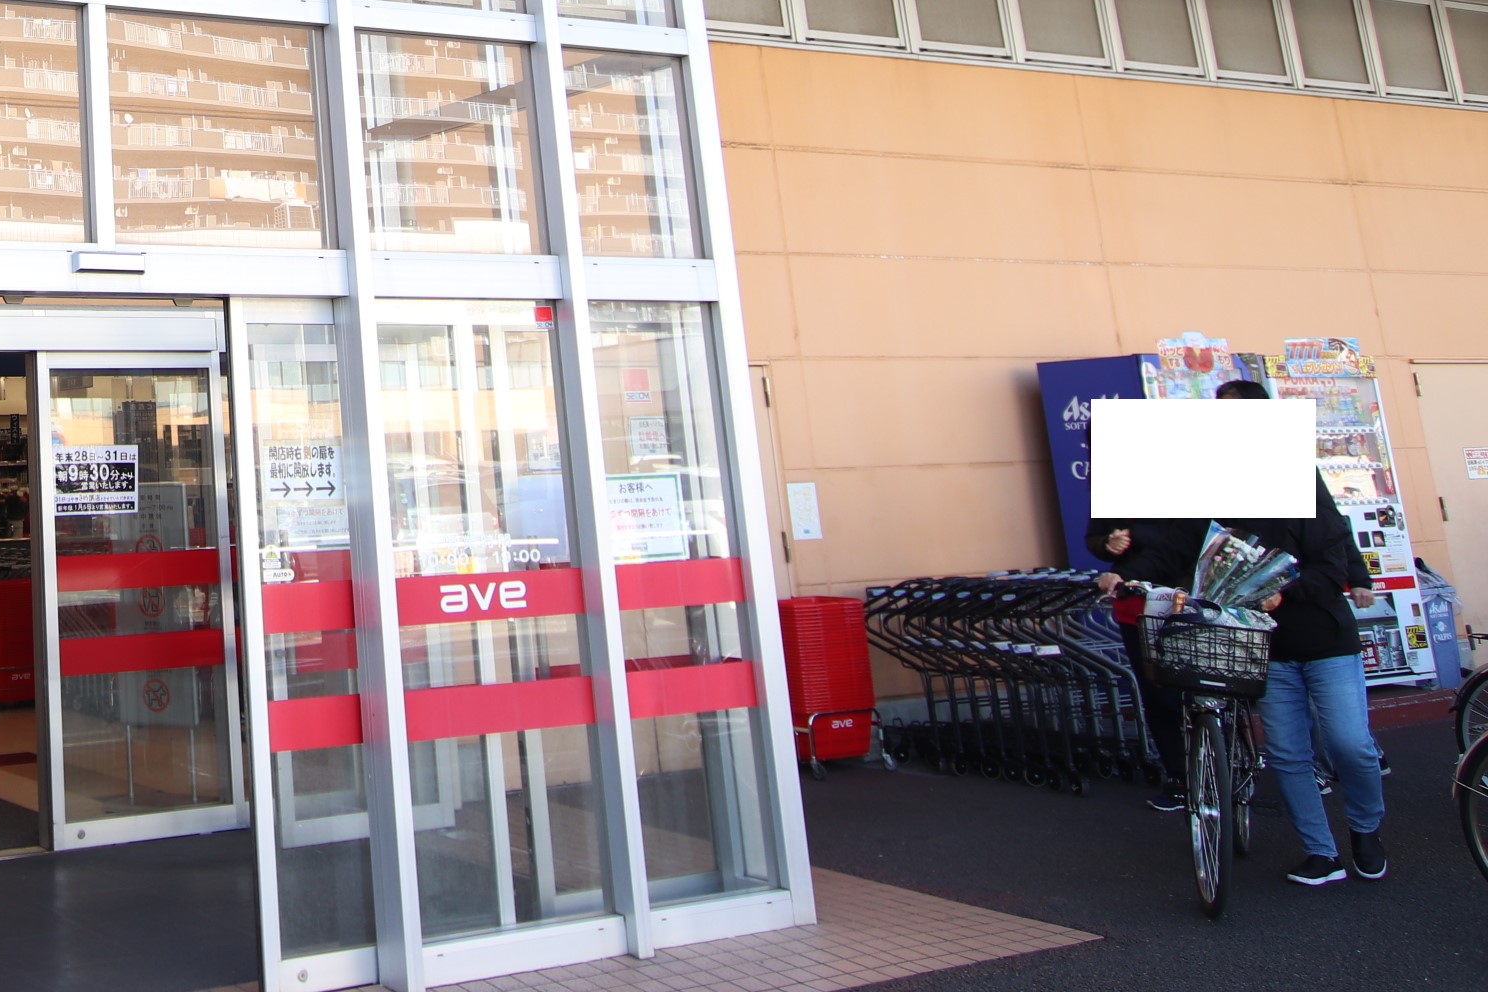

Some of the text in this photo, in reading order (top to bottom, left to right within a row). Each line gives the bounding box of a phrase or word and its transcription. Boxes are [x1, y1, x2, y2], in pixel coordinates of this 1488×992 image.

[440, 580, 528, 614] ave
[12, 672, 31, 681] ave
[831, 718, 854, 729] ave
